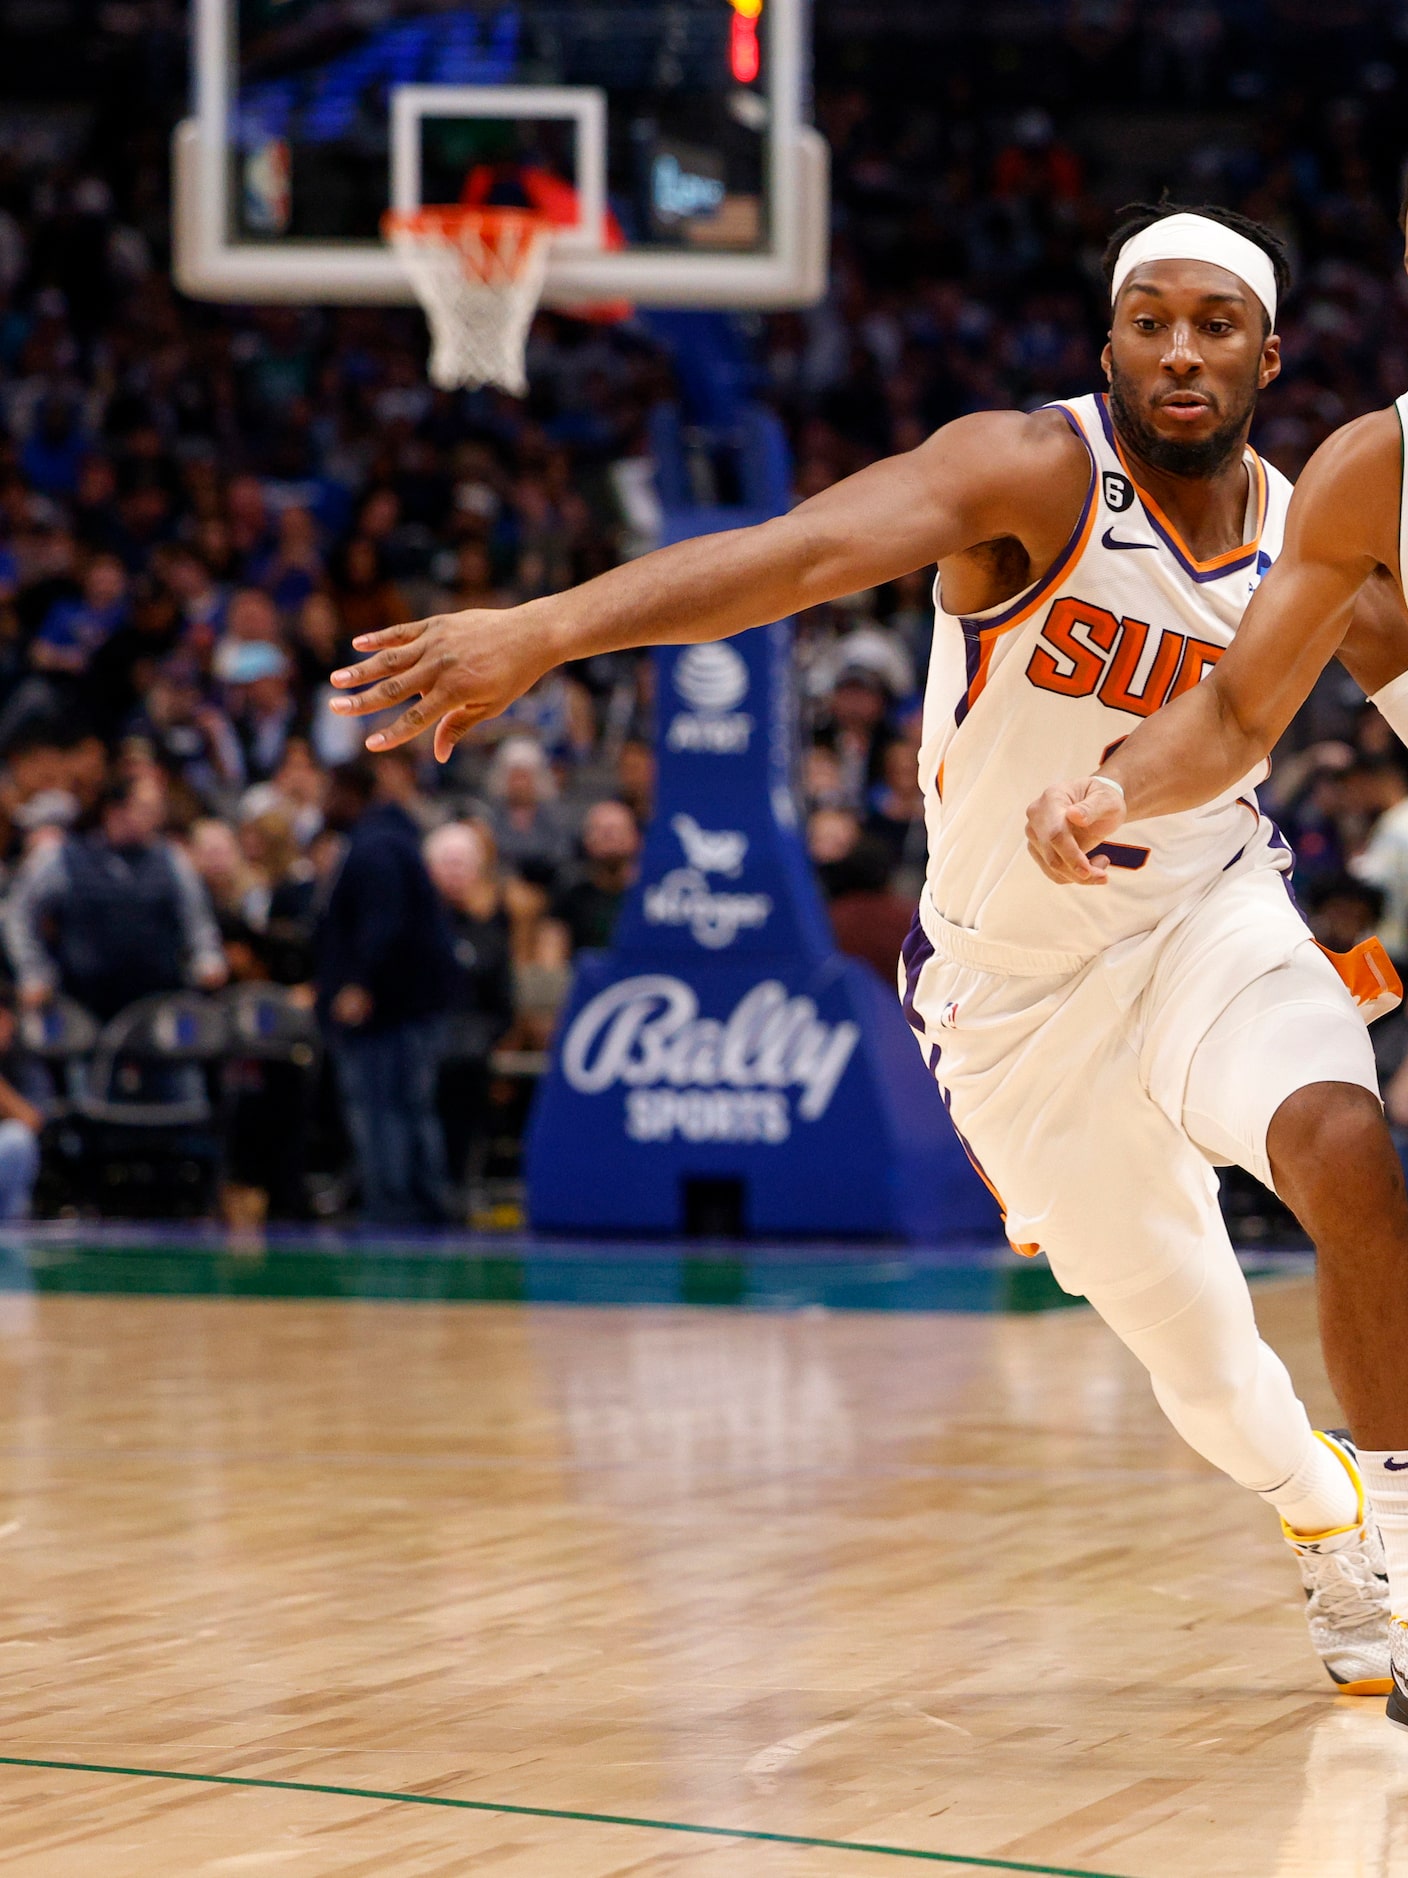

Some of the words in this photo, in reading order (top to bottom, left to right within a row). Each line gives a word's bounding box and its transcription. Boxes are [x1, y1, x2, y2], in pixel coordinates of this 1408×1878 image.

[1105, 476, 1125, 508] 6
[643, 867, 772, 950] Kroger
[562, 973, 861, 1122] Bally
[625, 1089, 790, 1144] SPORTS
